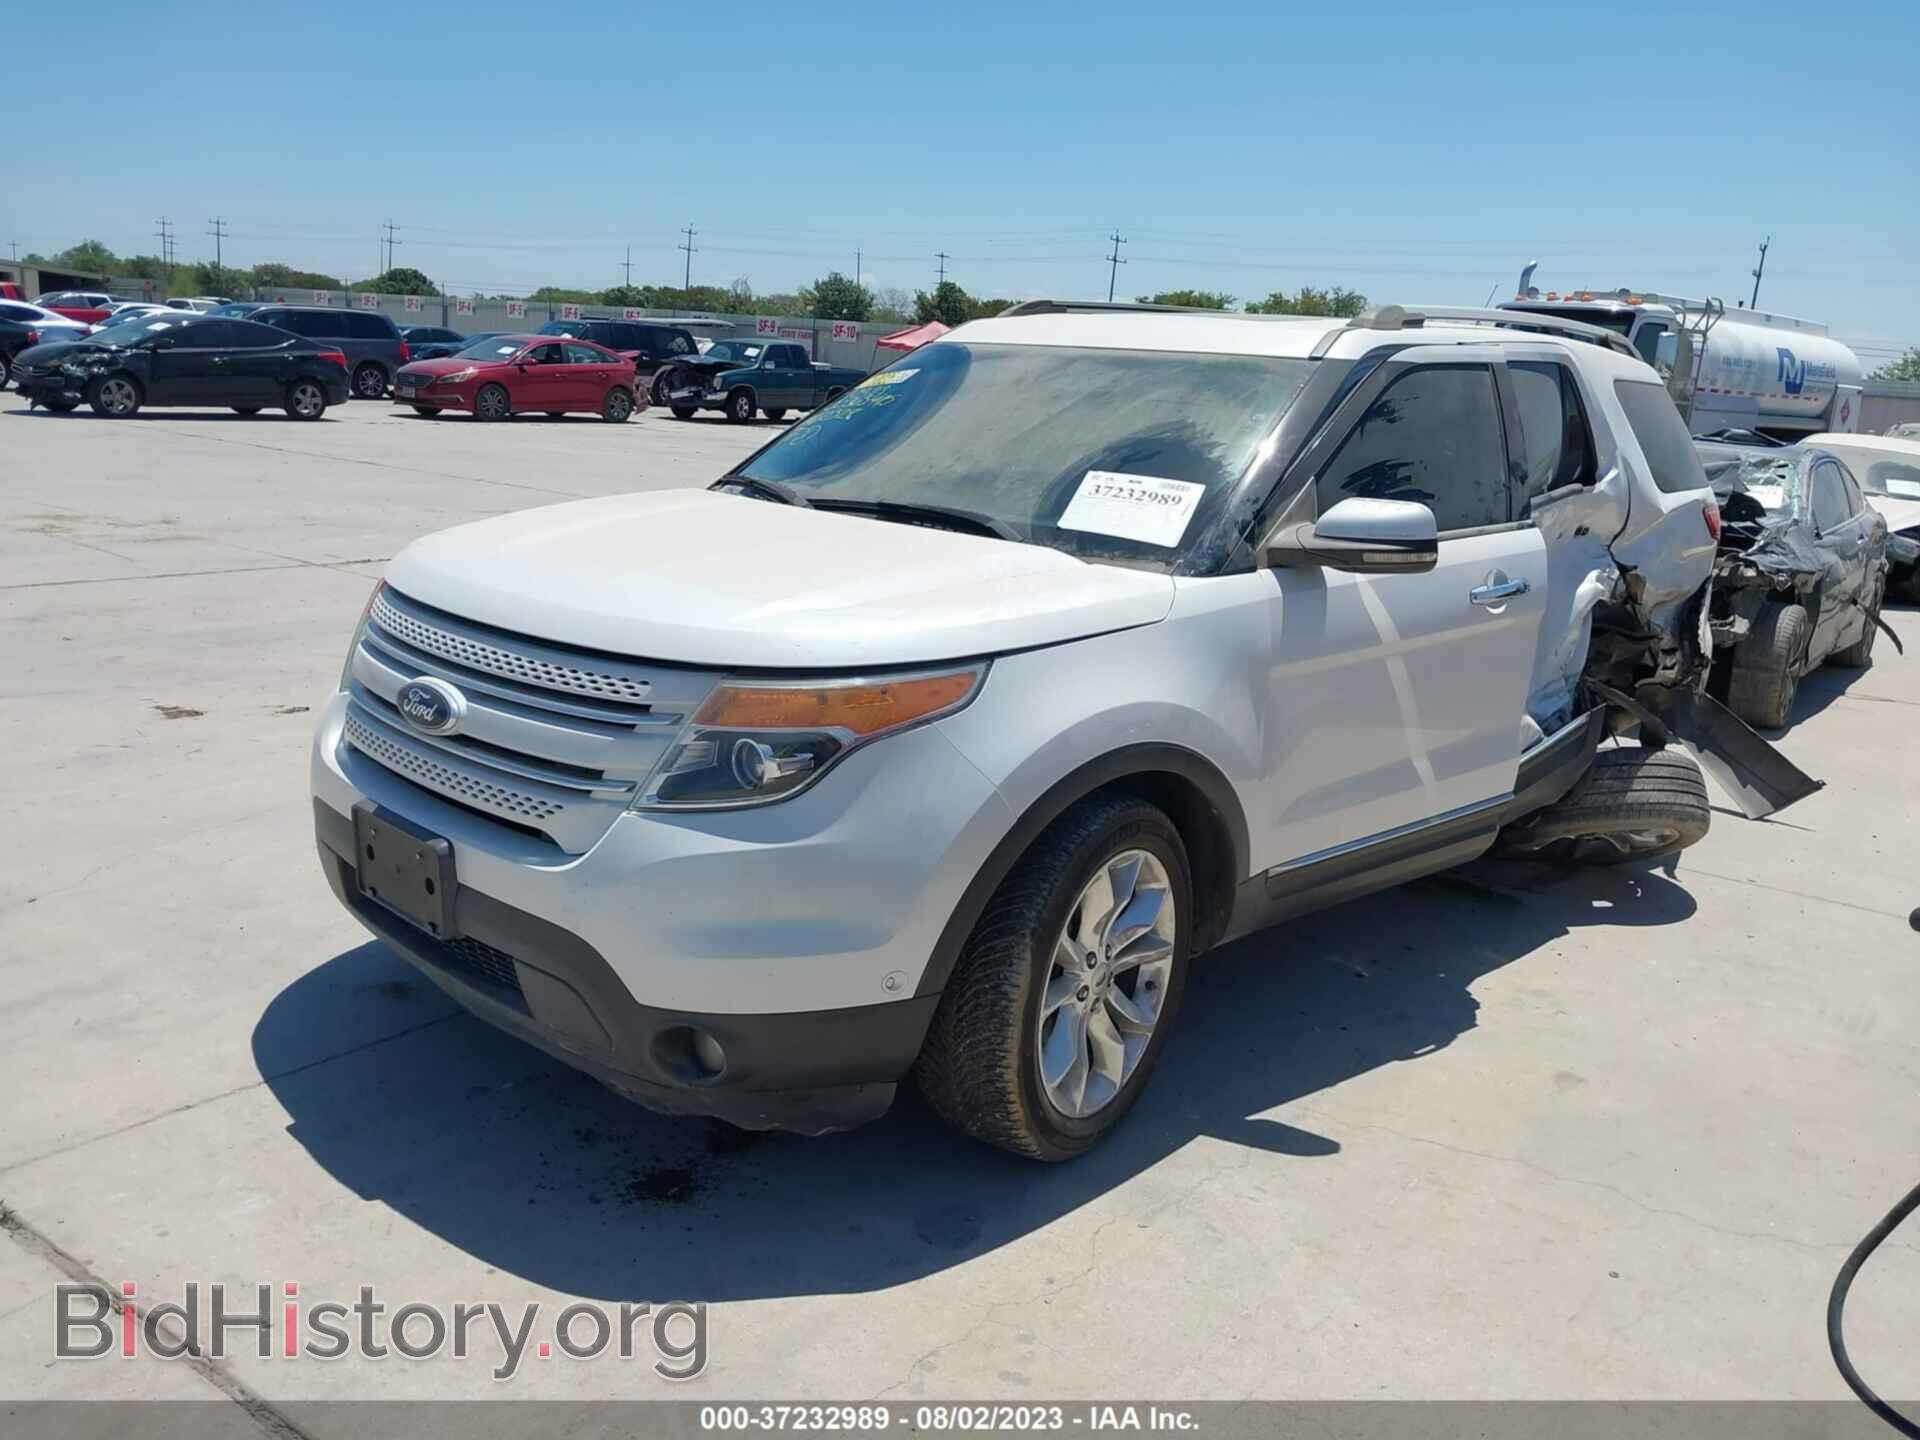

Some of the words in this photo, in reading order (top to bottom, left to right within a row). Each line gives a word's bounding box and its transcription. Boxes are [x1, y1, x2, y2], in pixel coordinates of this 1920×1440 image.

[758, 319, 776, 333] SF-9
[833, 324, 856, 338] SF-10
[1088, 484, 1183, 505] 37232989
[403, 687, 438, 721] Ford
